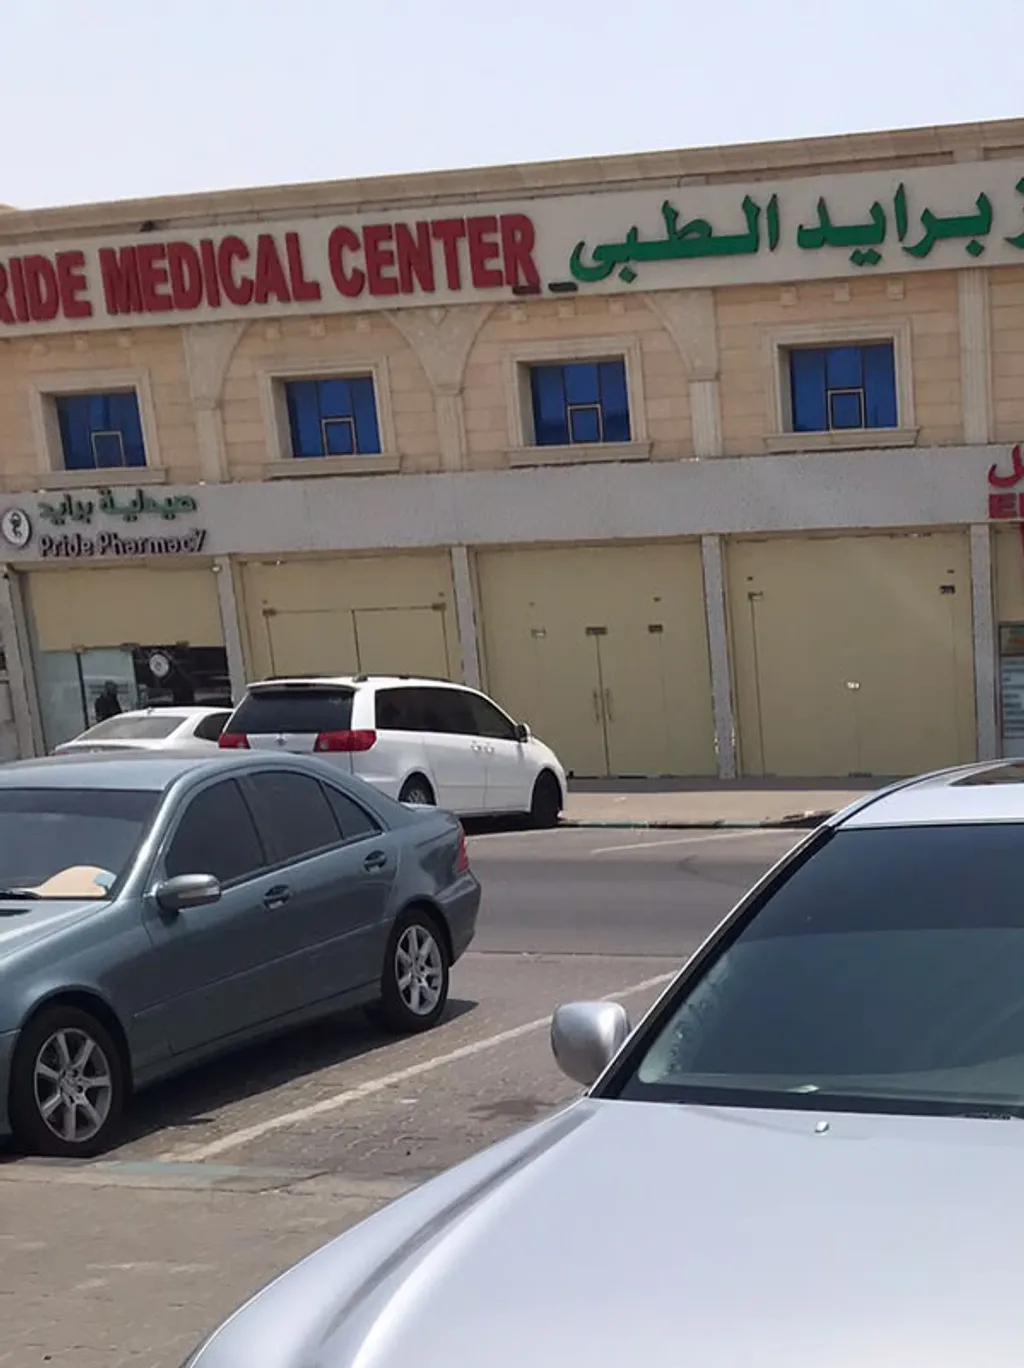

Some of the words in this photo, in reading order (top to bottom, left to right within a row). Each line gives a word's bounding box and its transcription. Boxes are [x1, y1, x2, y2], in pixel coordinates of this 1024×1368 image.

[98, 232, 322, 315] MEDICAL
[328, 213, 540, 298] CENTER
[796, 181, 994, 267] برايد
[39, 533, 95, 558] Pride
[98, 529, 207, 556] Pharmacy
